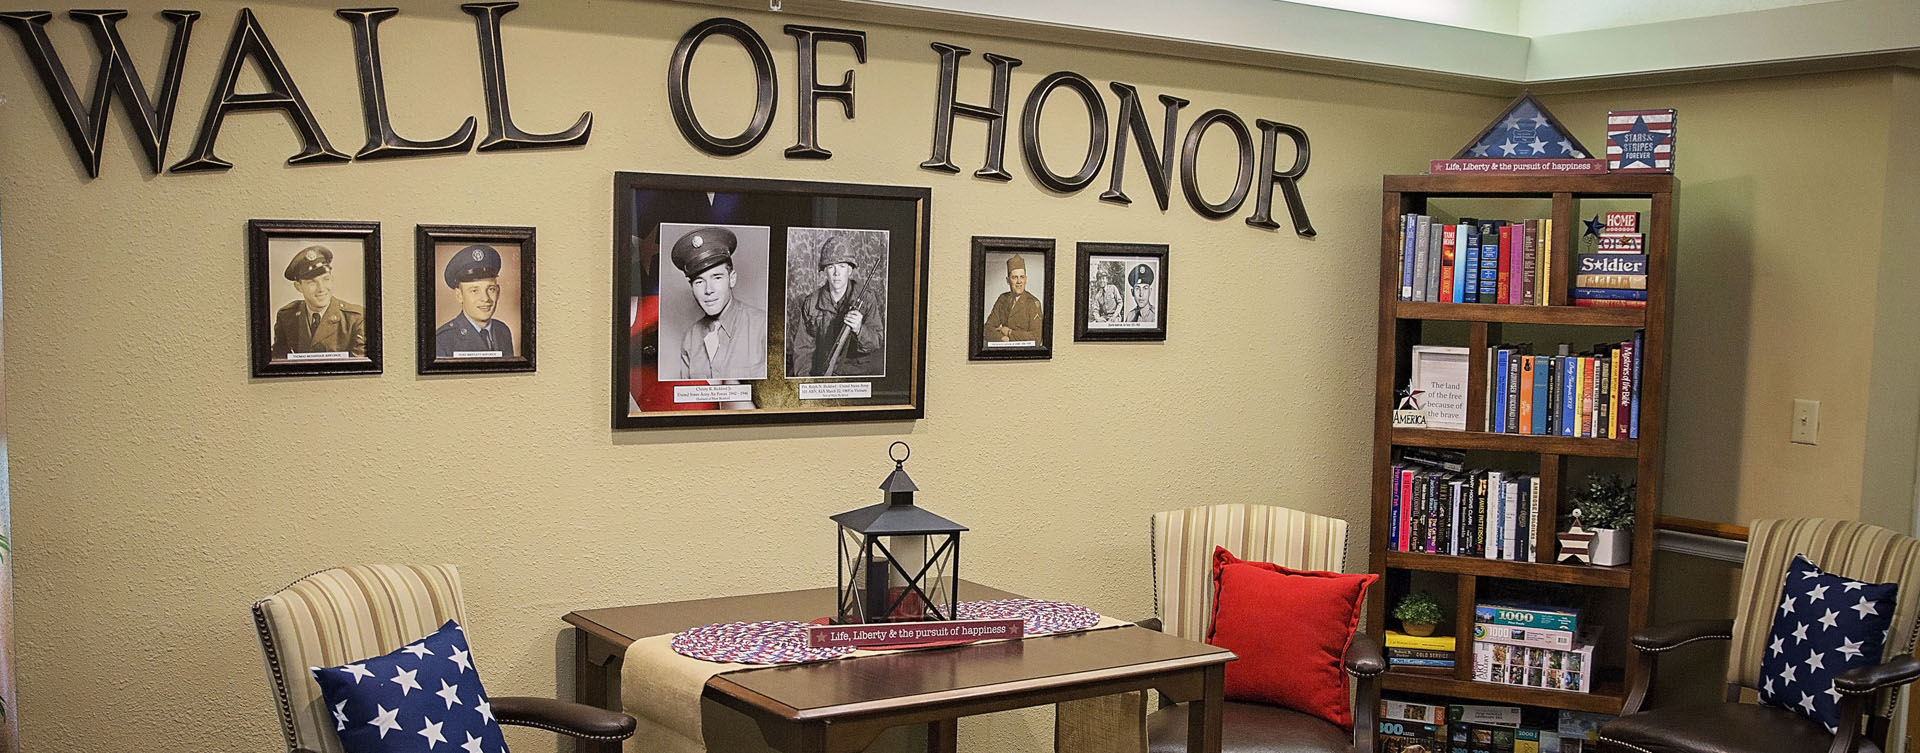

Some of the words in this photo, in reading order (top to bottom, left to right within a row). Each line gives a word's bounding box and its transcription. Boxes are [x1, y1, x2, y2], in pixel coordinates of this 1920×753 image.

[0, 1, 592, 178] WALL
[667, 16, 868, 160] OF
[920, 41, 1317, 238] HONOR
[1625, 134, 1646, 142] STARS
[1624, 143, 1653, 152] STRIPES
[1445, 163, 1461, 171] Life,
[1463, 163, 1490, 171] Liberty
[1513, 163, 1541, 171] pursuit
[1542, 162, 1550, 170] of
[1552, 162, 1591, 171] happiness
[1607, 214, 1635, 227] HOME
[1621, 347, 1632, 376] Mysteries
[1622, 382, 1631, 391] the
[1621, 392, 1630, 407] Bible
[1499, 611, 1534, 622] 1000
[830, 632, 851, 642] Life,
[853, 630, 887, 641] Liberty
[888, 630, 897, 638] &
[898, 628, 914, 638] the
[915, 627, 949, 639] pursuit
[950, 626, 961, 636] of
[961, 625, 1006, 636] happiness
[1489, 627, 1509, 638] 1000
[1476, 663, 1484, 679] ART
